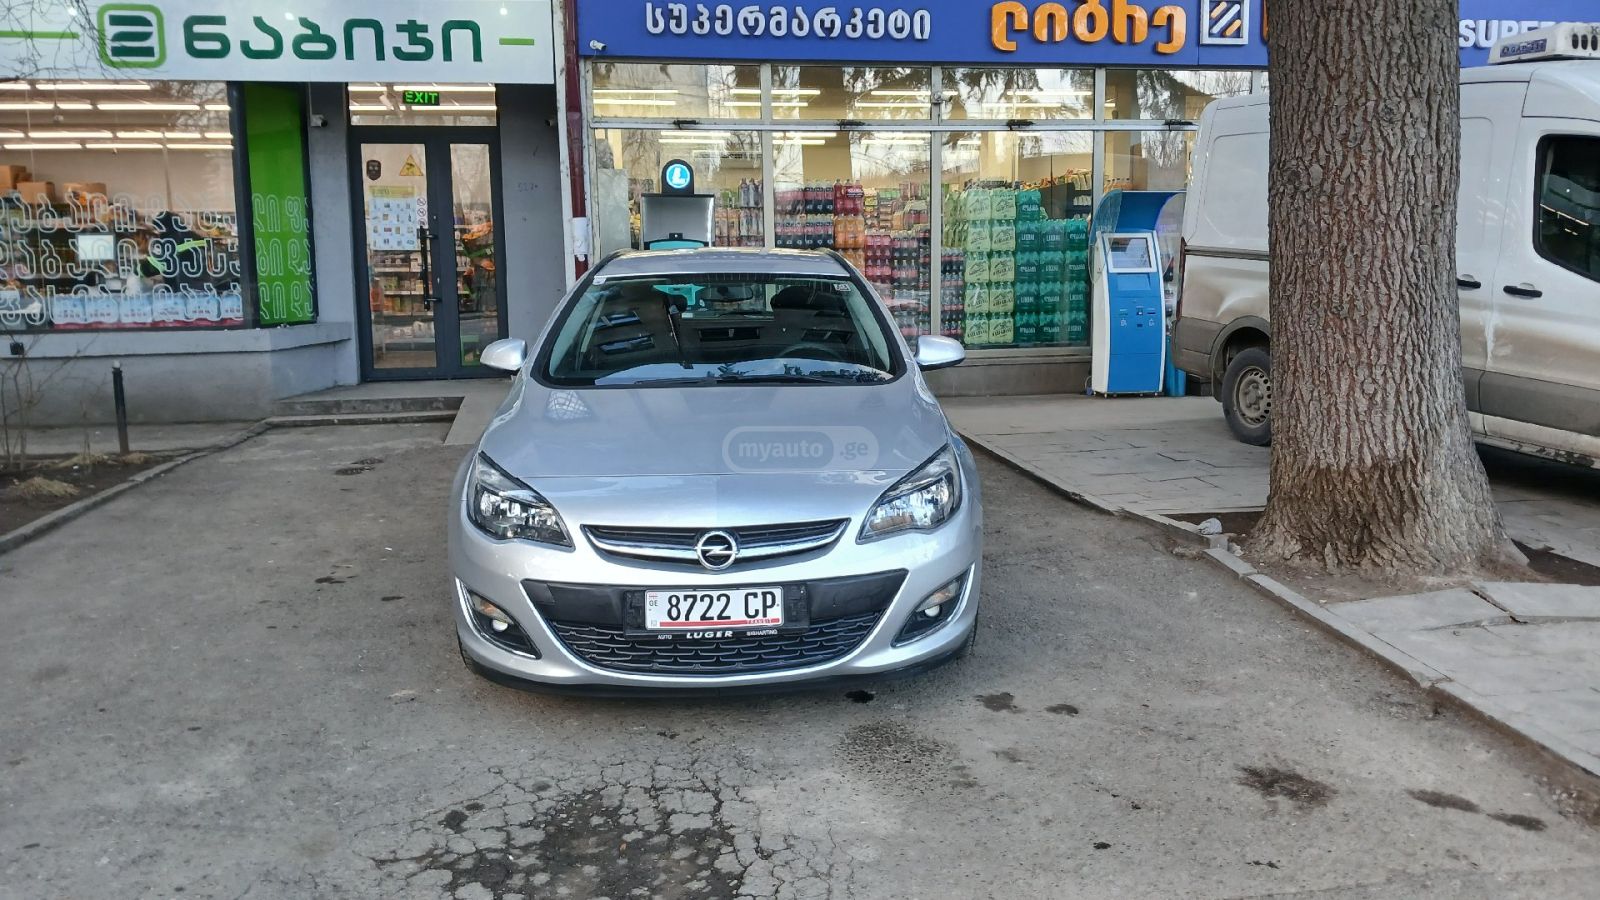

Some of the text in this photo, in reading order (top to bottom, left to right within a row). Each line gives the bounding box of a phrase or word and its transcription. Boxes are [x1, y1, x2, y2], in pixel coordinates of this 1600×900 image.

[183, 15, 482, 62] ნაბიჯი
[646, 3, 931, 40] სუპერმარკეტი
[992, 0, 1187, 54] ლიბრე
[1459, 19, 1556, 48] SUPE
[405, 91, 438, 104] EXIT
[0, 192, 137, 233] აბალი
[667, 590, 776, 621] 8722 CP
[686, 631, 733, 639] LUGER
